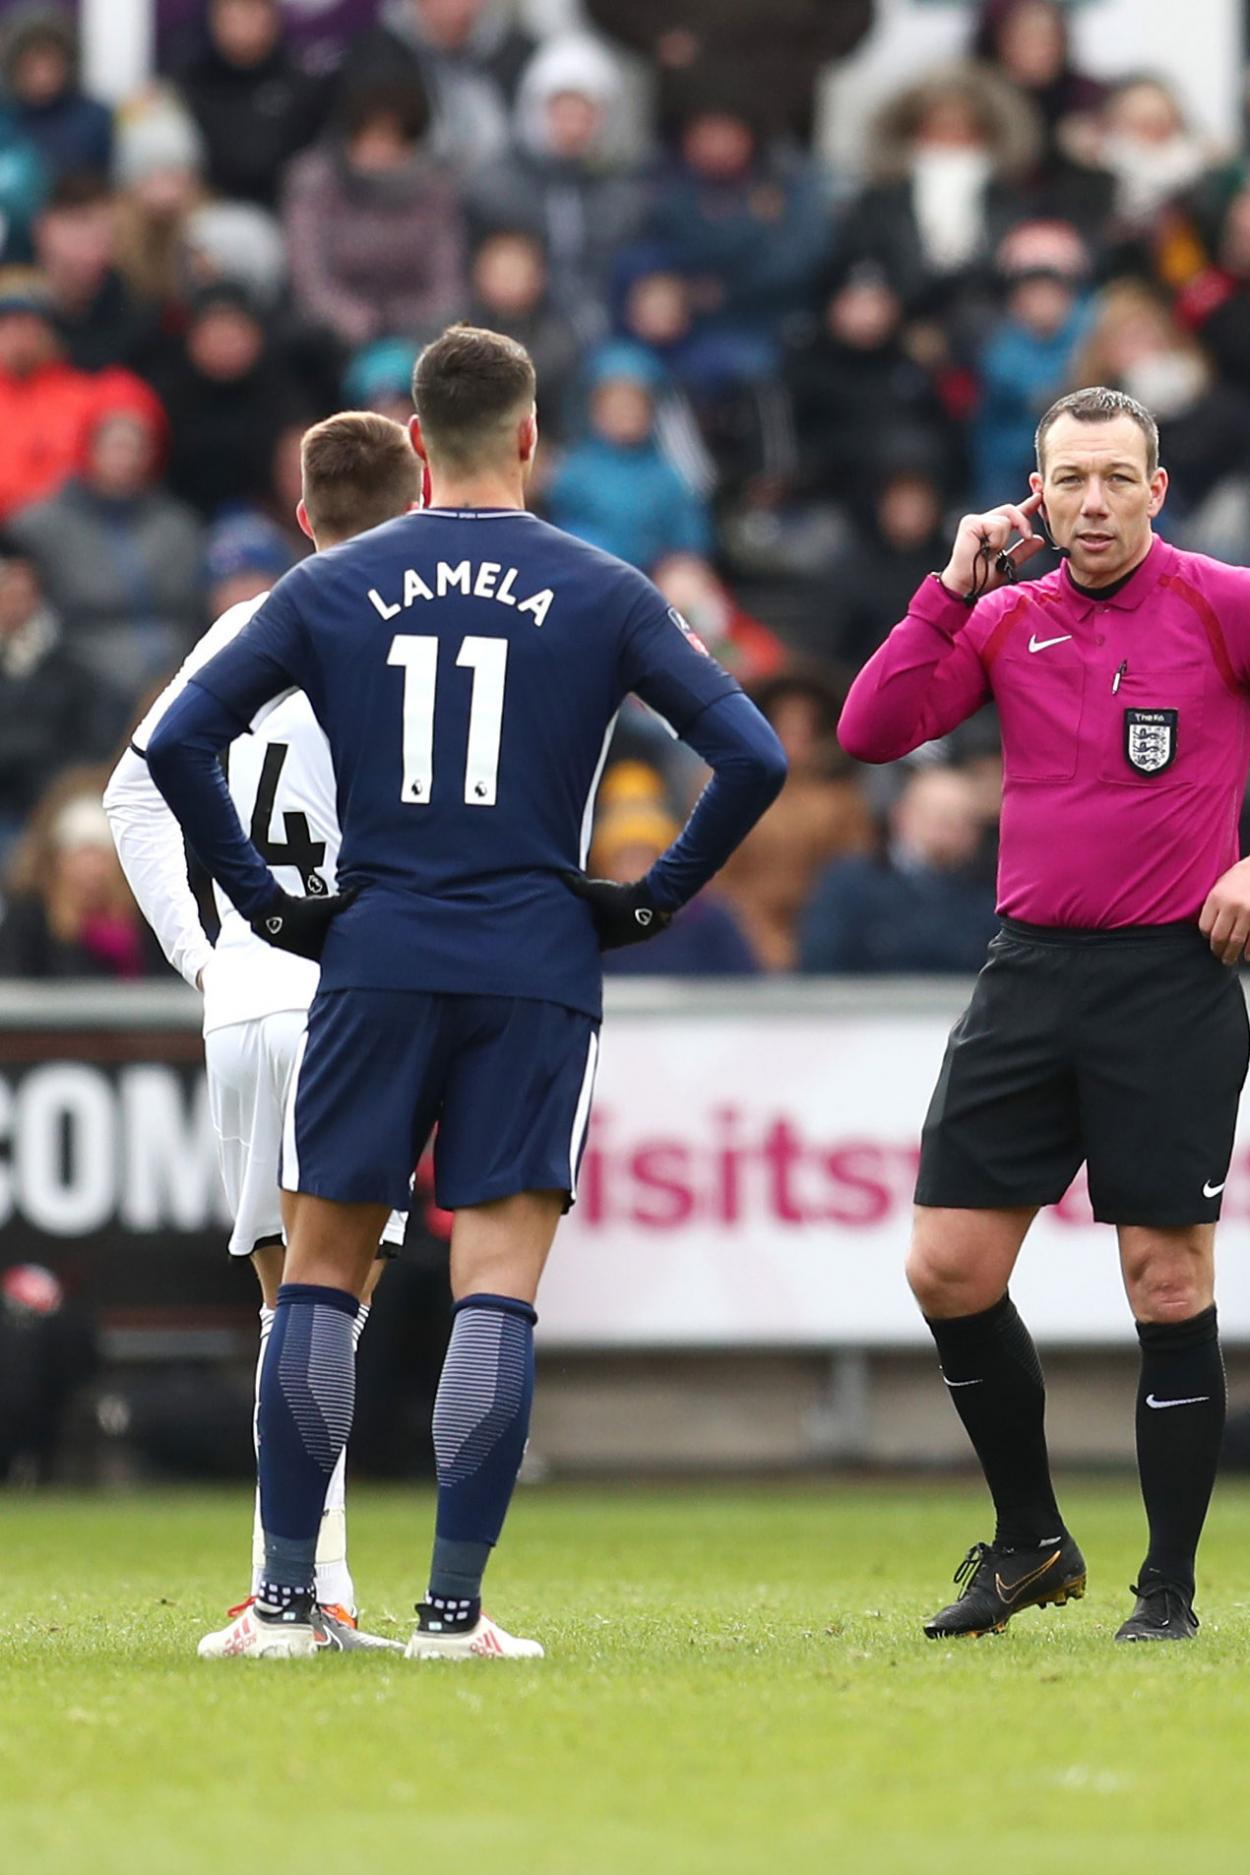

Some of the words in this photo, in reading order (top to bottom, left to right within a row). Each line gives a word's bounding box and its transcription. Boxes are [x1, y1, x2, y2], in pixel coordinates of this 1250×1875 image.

[367, 560, 554, 627] LAMELA
[386, 634, 508, 806] 11
[250, 742, 326, 896] 4
[0, 1060, 236, 1238] OM
